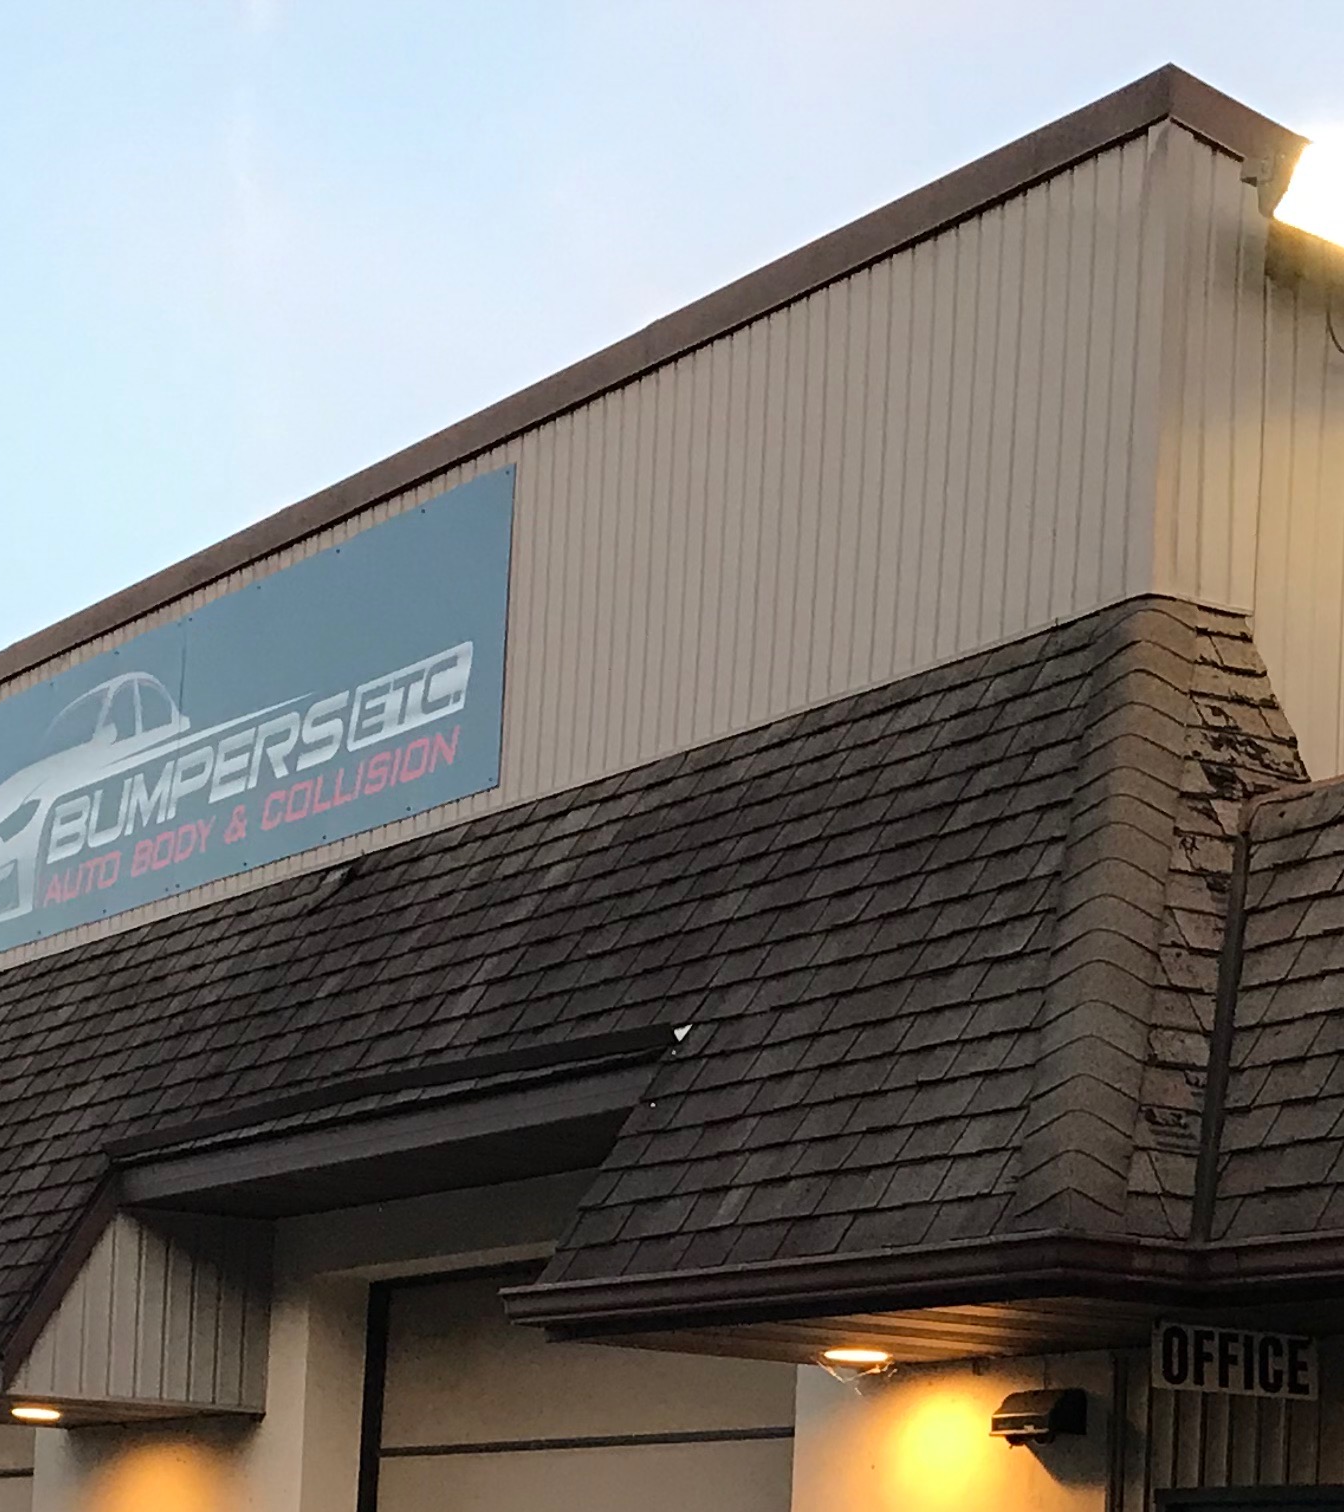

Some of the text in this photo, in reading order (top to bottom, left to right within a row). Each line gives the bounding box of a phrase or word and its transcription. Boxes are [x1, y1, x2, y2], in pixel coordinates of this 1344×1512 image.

[44, 726, 460, 905] AUTO BODY & COLLISION
[47, 691, 349, 864] BUMPERS
[1161, 1325, 1310, 1395] OFFICE
